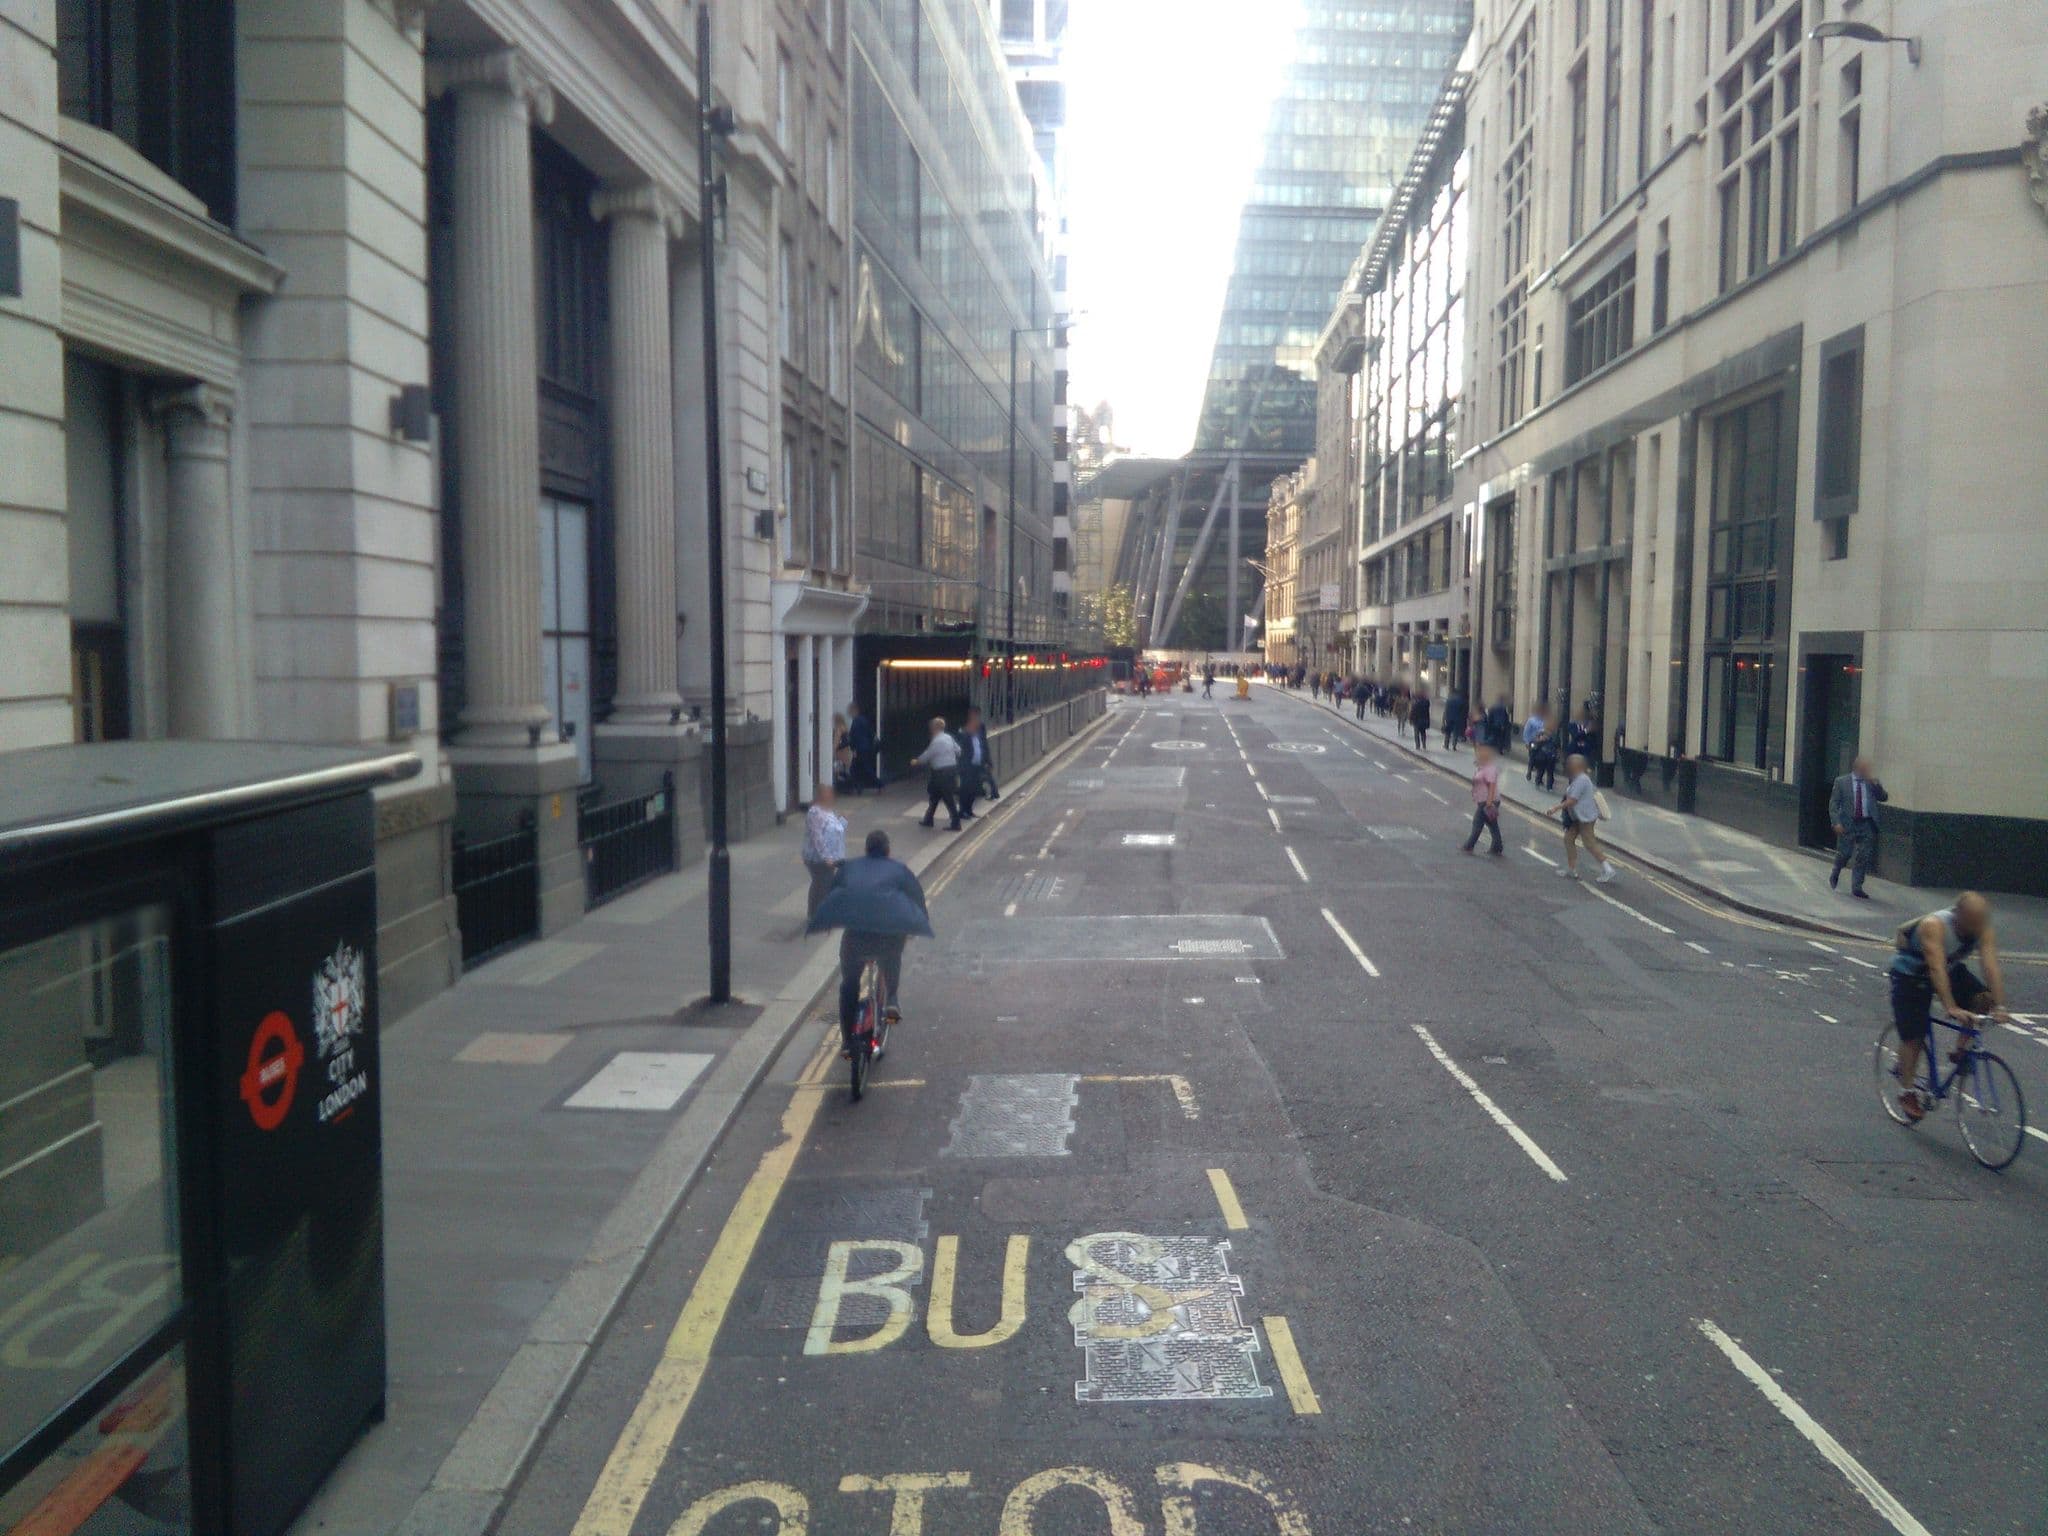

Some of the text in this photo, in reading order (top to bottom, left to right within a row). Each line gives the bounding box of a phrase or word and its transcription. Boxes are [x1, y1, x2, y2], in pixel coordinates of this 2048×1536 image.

[329, 1047, 354, 1081] CITY
[318, 1069, 367, 1122] LONDON
[803, 1231, 1176, 1355] BUS
